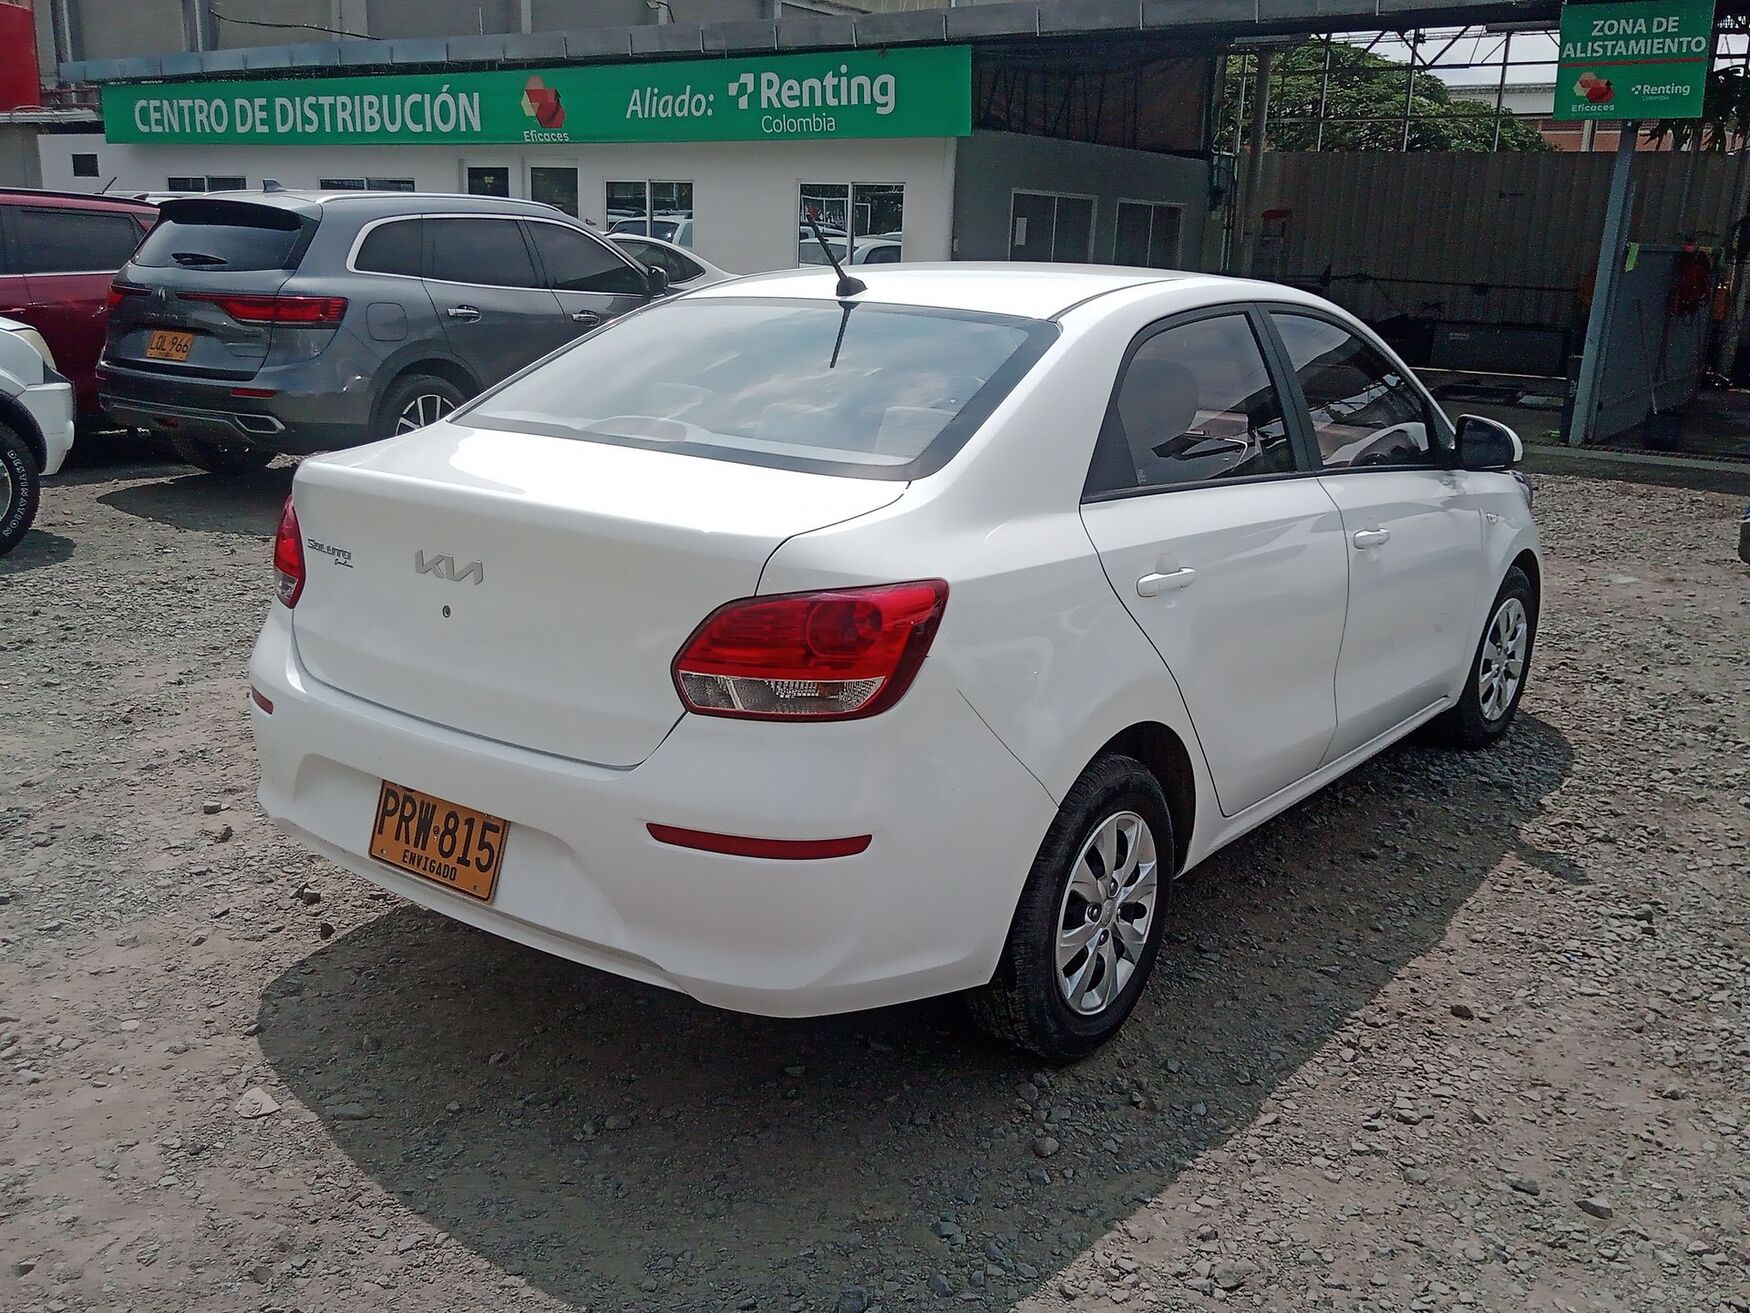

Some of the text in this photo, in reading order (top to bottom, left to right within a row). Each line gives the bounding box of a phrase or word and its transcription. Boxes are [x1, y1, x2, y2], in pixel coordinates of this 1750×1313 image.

[1591, 16, 1680, 36] ZONA DE
[1562, 36, 1707, 58] ALISTAMIENTO
[760, 65, 896, 115] Renting
[1642, 82, 1691, 96] Renting
[134, 84, 482, 134] CENTRO DE DISTRIBUCIÓN
[626, 85, 715, 119] Aliado:
[1571, 103, 1615, 113] Eficaces
[761, 112, 837, 134] Colombia
[523, 129, 570, 143] Eficaces
[169, 336, 191, 353] 966
[414, 549, 484, 586] KIA
[402, 849, 458, 882] ENVIGADO
